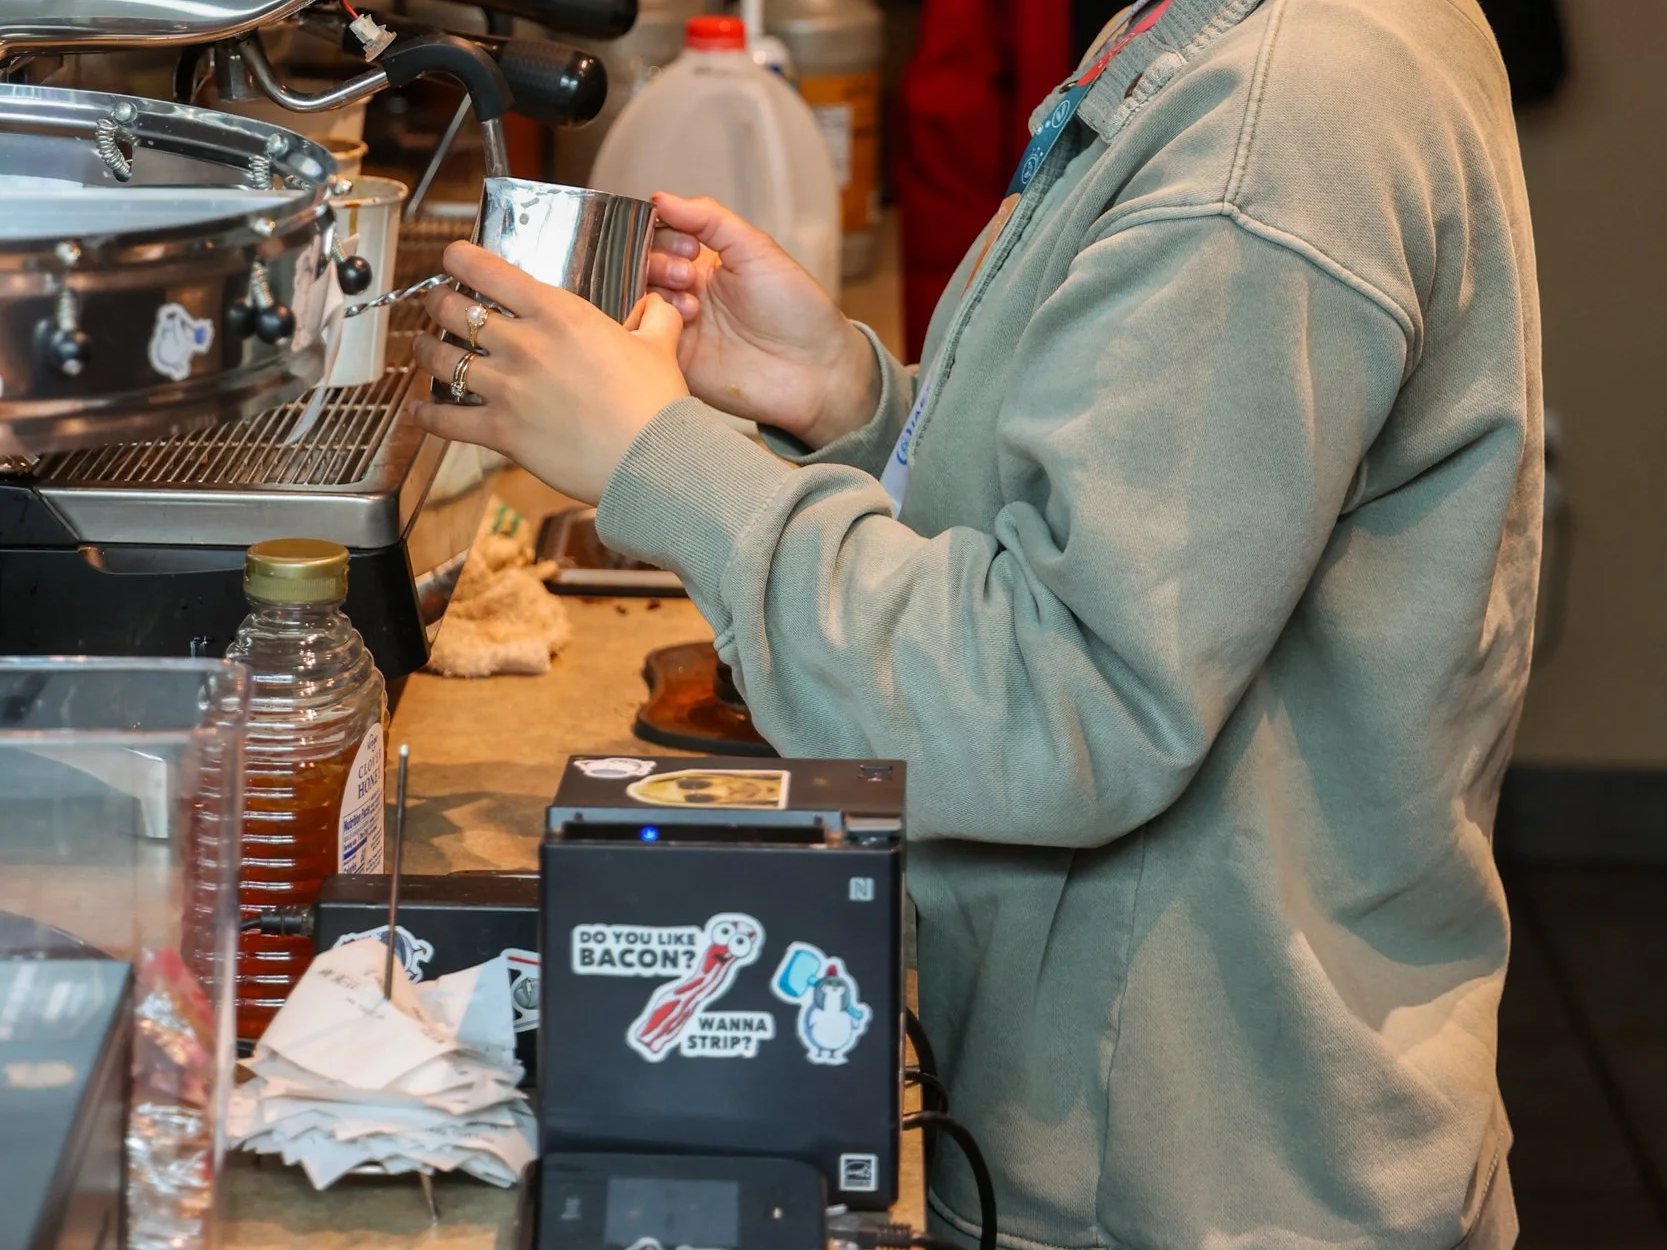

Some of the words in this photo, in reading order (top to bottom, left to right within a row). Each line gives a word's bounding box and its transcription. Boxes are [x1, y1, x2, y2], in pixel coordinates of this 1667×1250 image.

[579, 931, 606, 945] DO
[612, 931, 652, 945] YOU
[657, 932, 696, 946] LIKE
[579, 948, 696, 969] BACON?
[698, 1017, 768, 1032] WANNA
[687, 1035, 752, 1050] STRIP?
